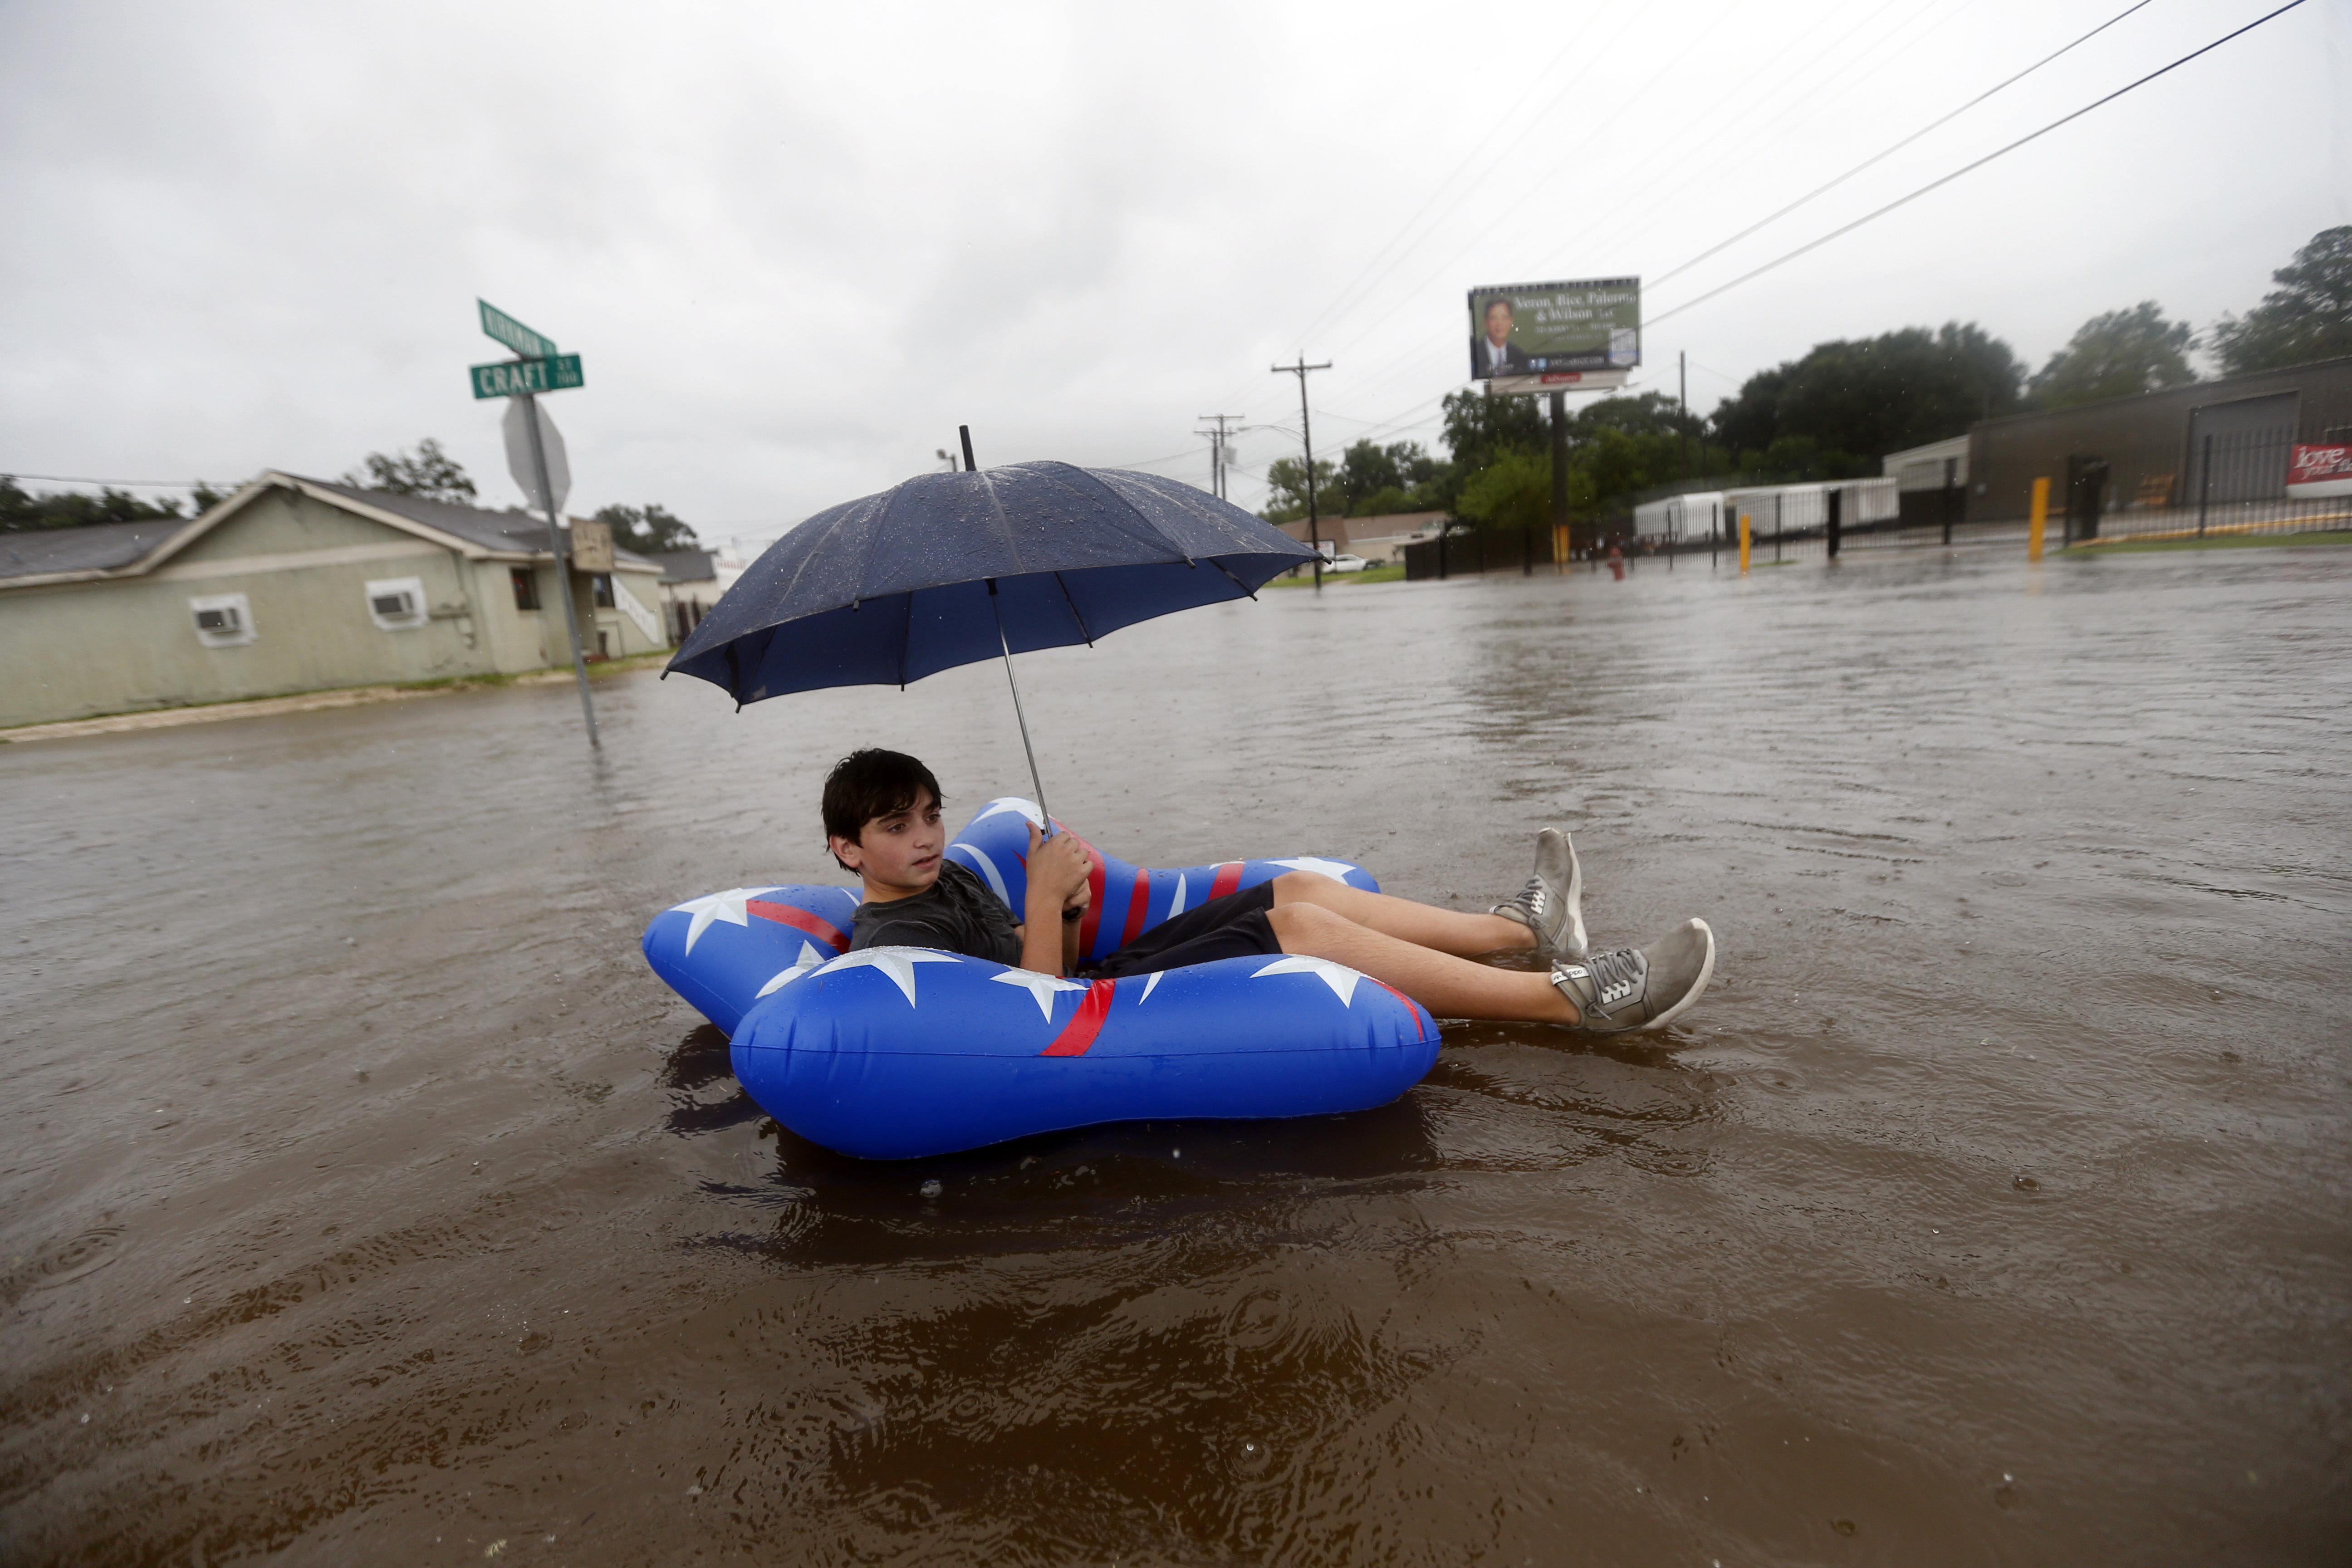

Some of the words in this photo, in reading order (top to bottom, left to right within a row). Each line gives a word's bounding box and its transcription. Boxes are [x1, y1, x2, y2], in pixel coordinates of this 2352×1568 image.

[1535, 310, 1547, 323] &
[1548, 306, 1593, 321] Wilson
[480, 362, 548, 396] CRAFT
[2294, 445, 2345, 468] love
